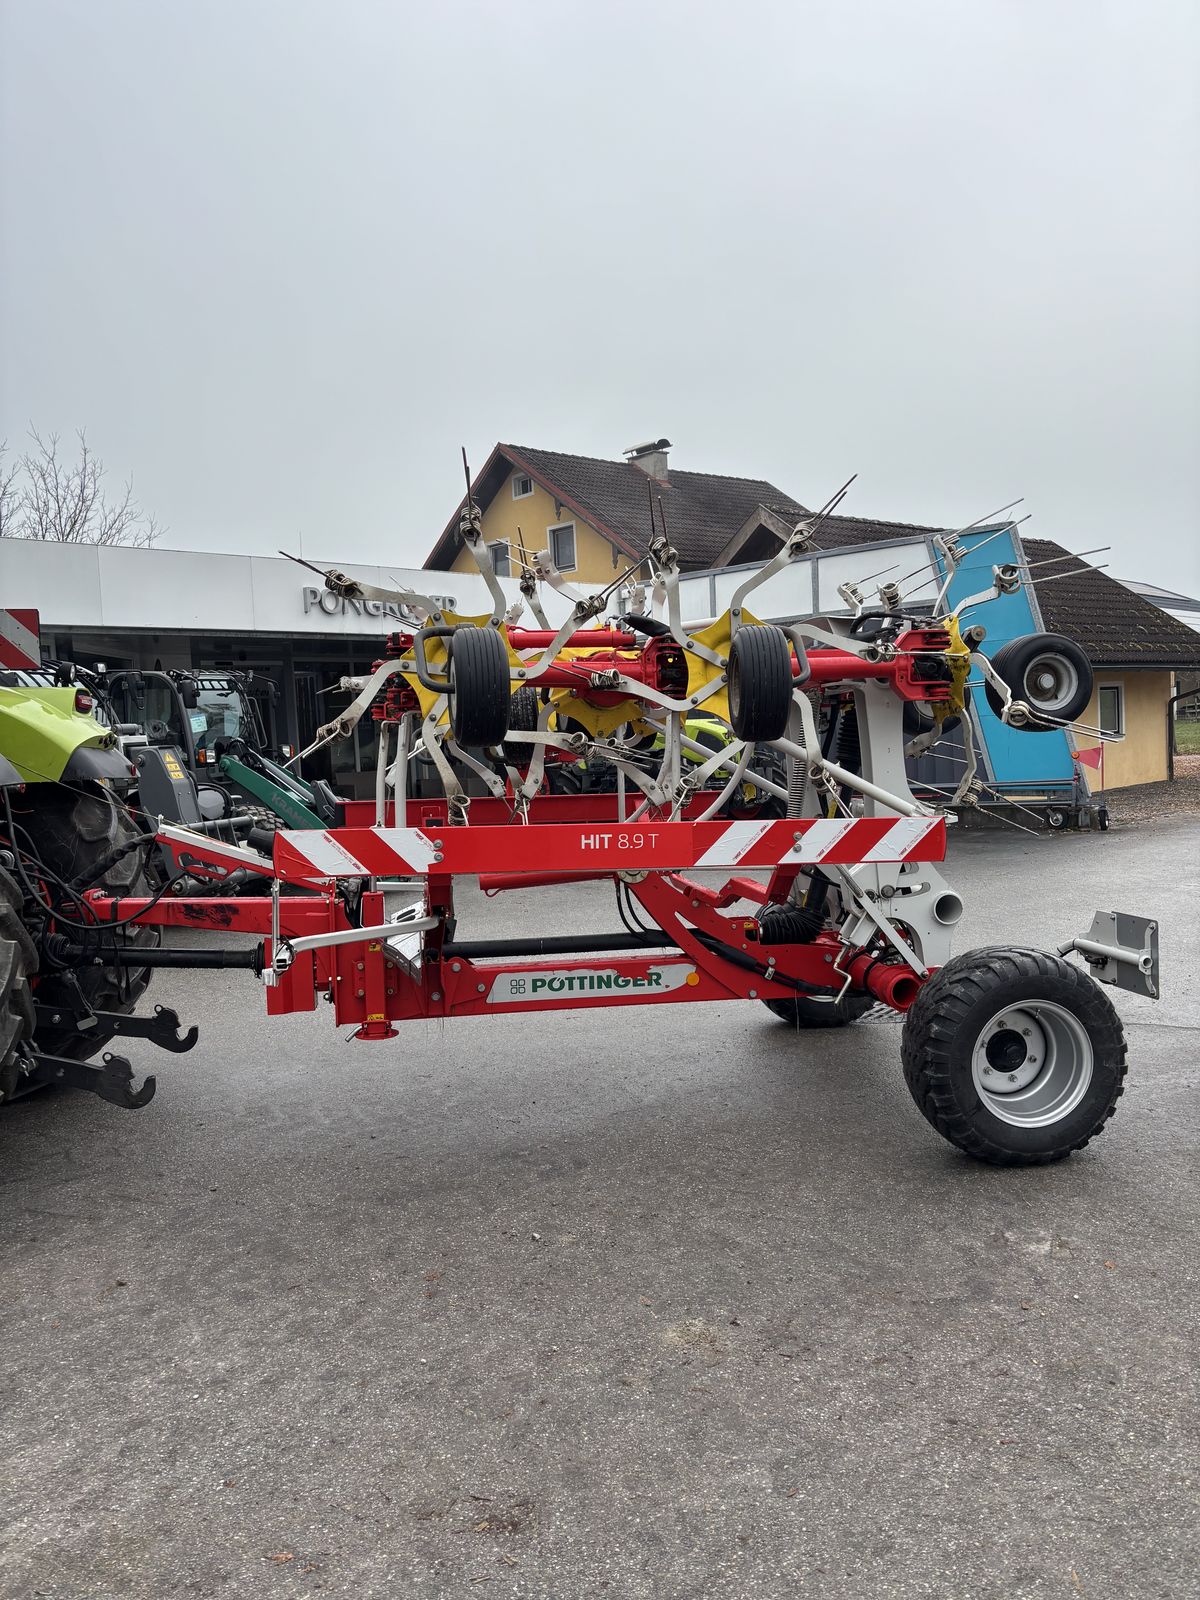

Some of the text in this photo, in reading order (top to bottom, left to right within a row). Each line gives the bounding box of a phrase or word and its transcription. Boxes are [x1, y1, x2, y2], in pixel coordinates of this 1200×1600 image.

[581, 833, 659, 849] HIT 8.9 T
